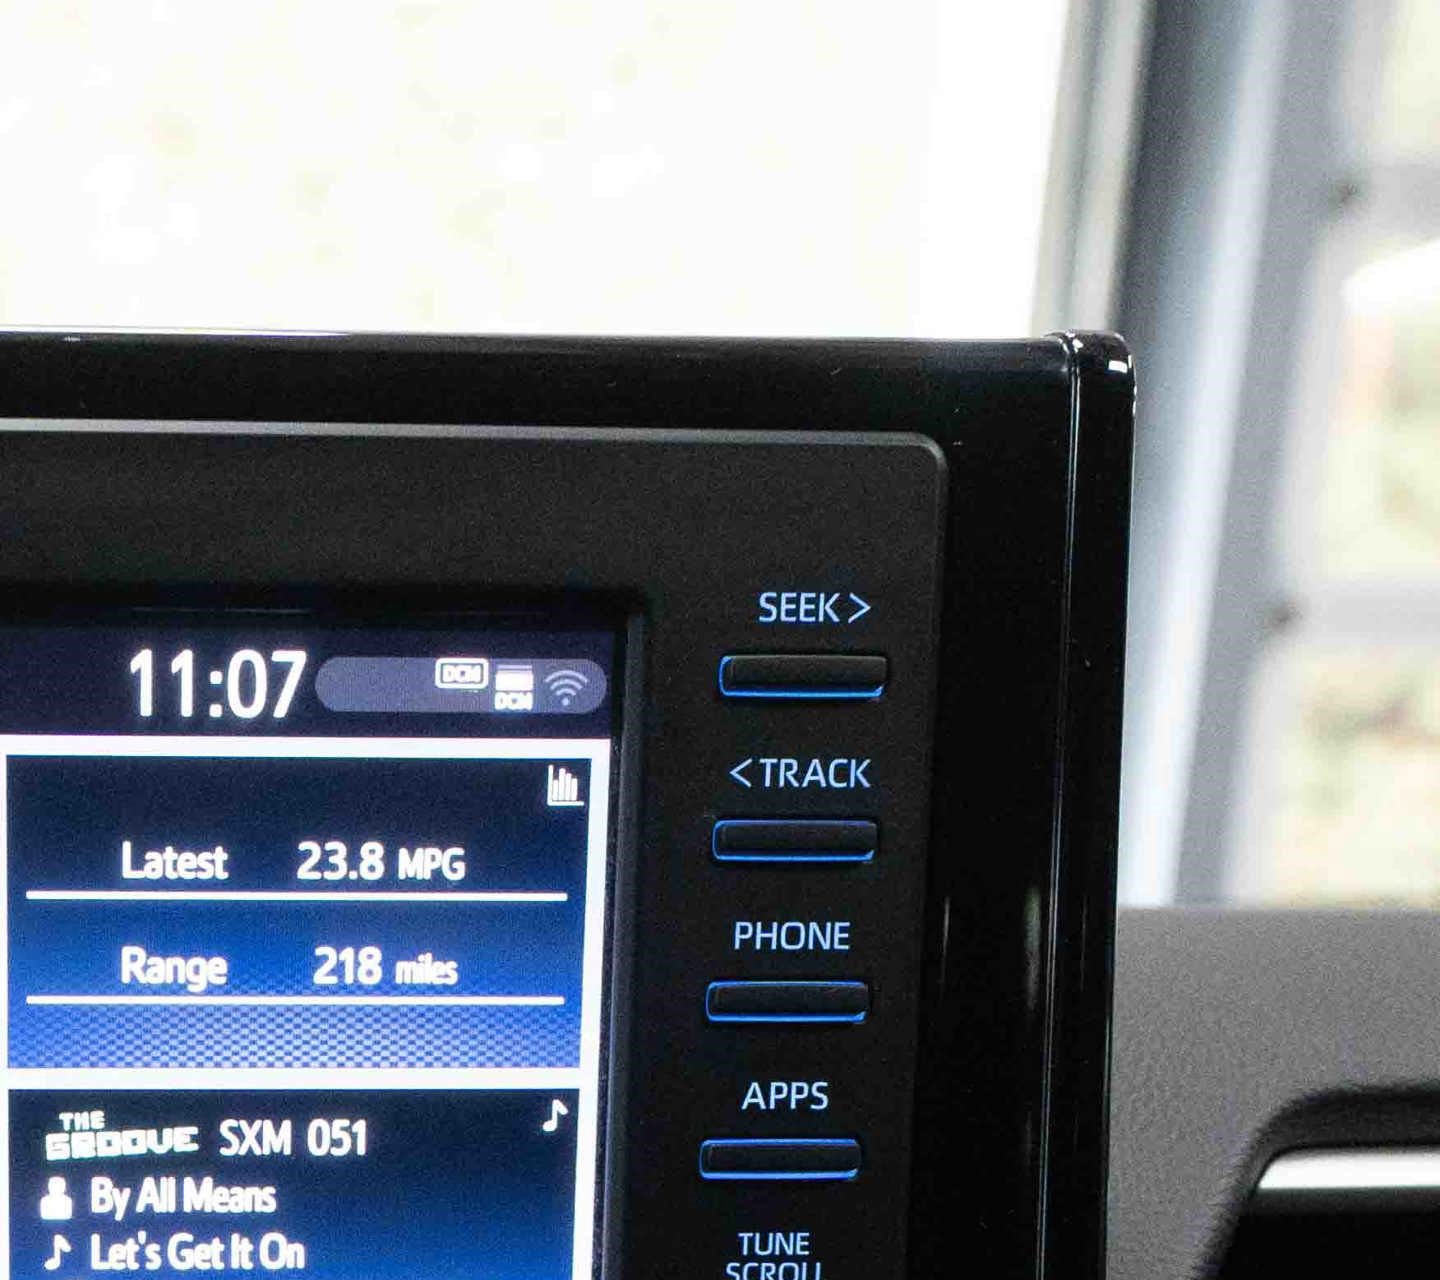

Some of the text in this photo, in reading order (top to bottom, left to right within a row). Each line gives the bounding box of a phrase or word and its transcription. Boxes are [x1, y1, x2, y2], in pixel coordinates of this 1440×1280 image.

[129, 648, 308, 720] 11:07
[121, 840, 466, 886] Latest 23.8 MPG
[734, 921, 851, 951] PHONE
[120, 946, 458, 992] Range 218 miles
[741, 1081, 829, 1111] APPS
[45, 1118, 367, 1161] GROOVE SXM 051
[58, 1109, 106, 1131] THE
[90, 1176, 277, 1222] By All Means
[90, 1232, 307, 1272] Let's Get It On
[737, 1232, 810, 1256] TUNE
